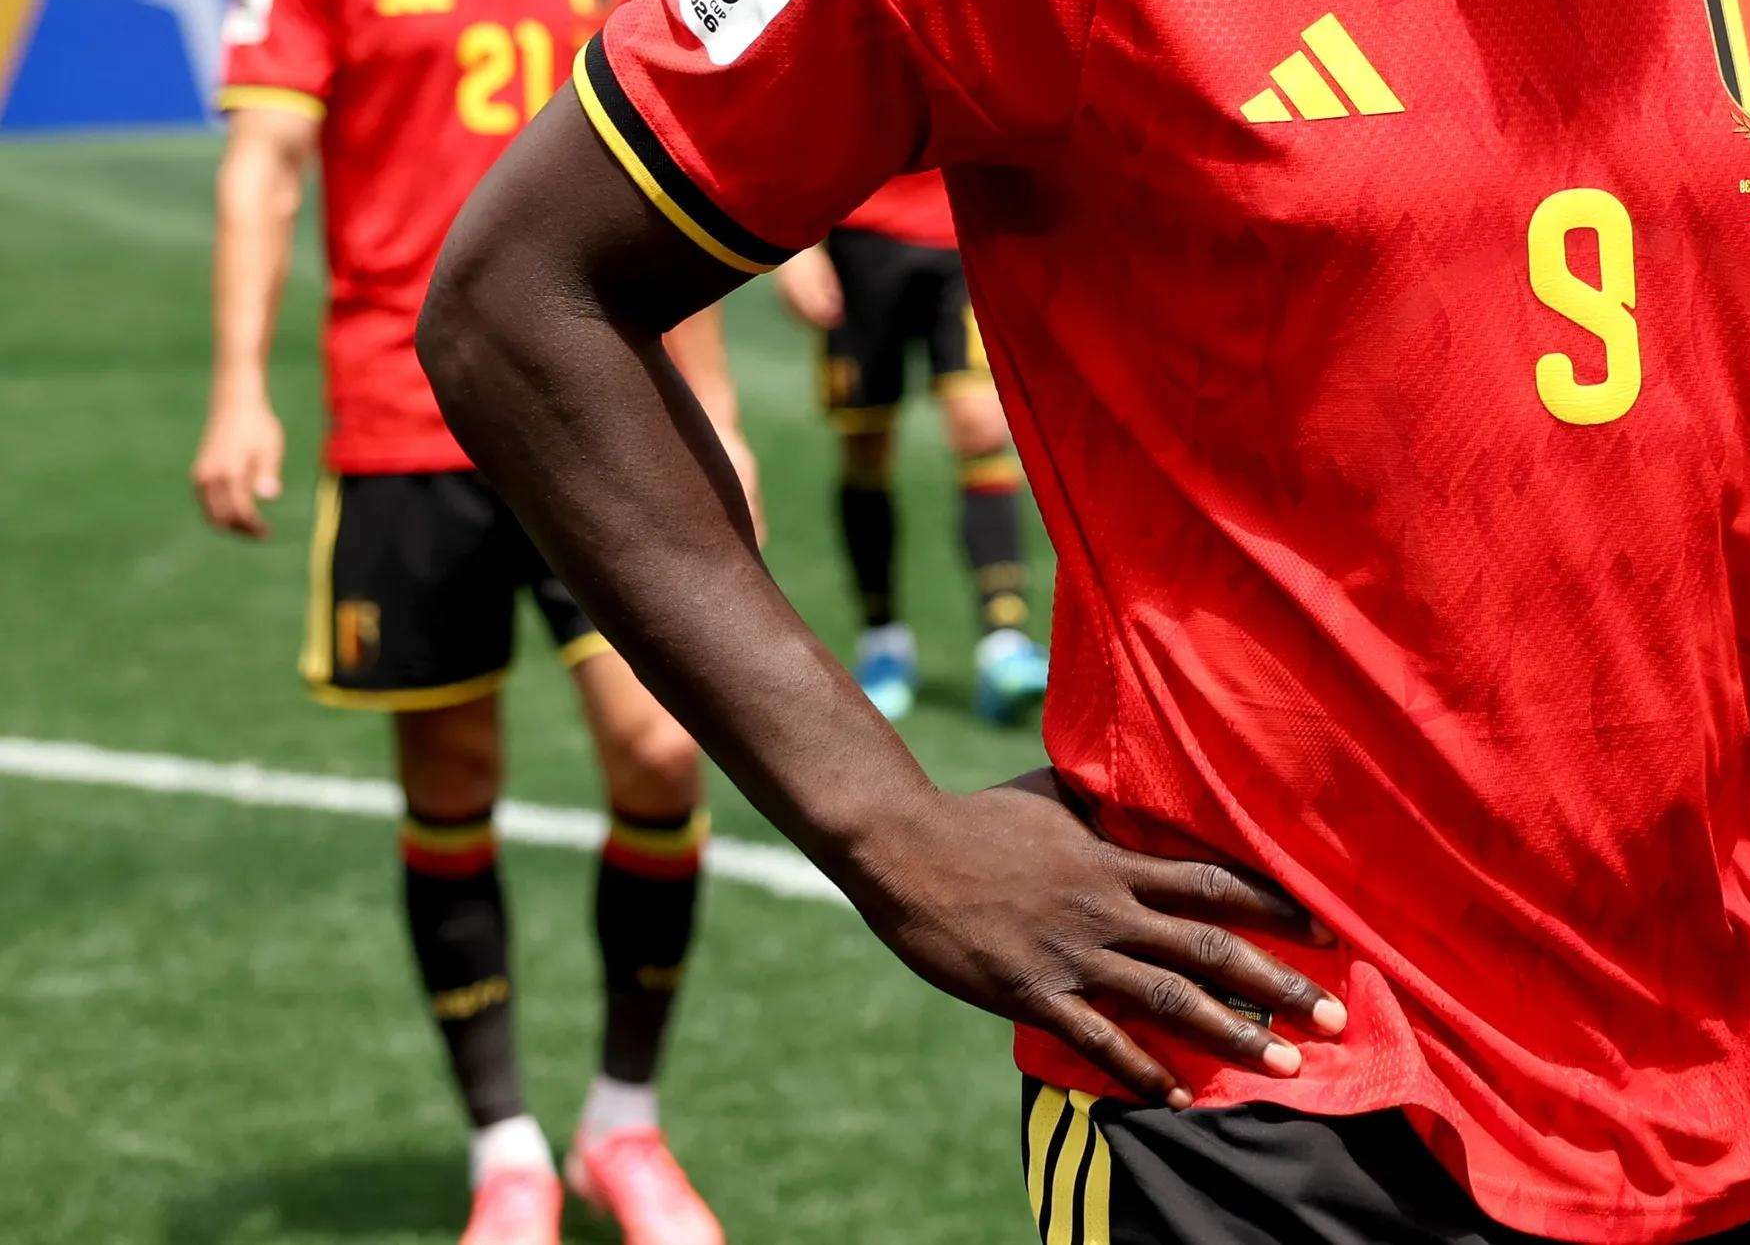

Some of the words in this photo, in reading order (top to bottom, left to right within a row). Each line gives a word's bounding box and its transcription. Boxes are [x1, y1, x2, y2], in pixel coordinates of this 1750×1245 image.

[709, 0, 727, 19] CUP
[456, 18, 555, 135] 21
[1527, 187, 1642, 425] 9
